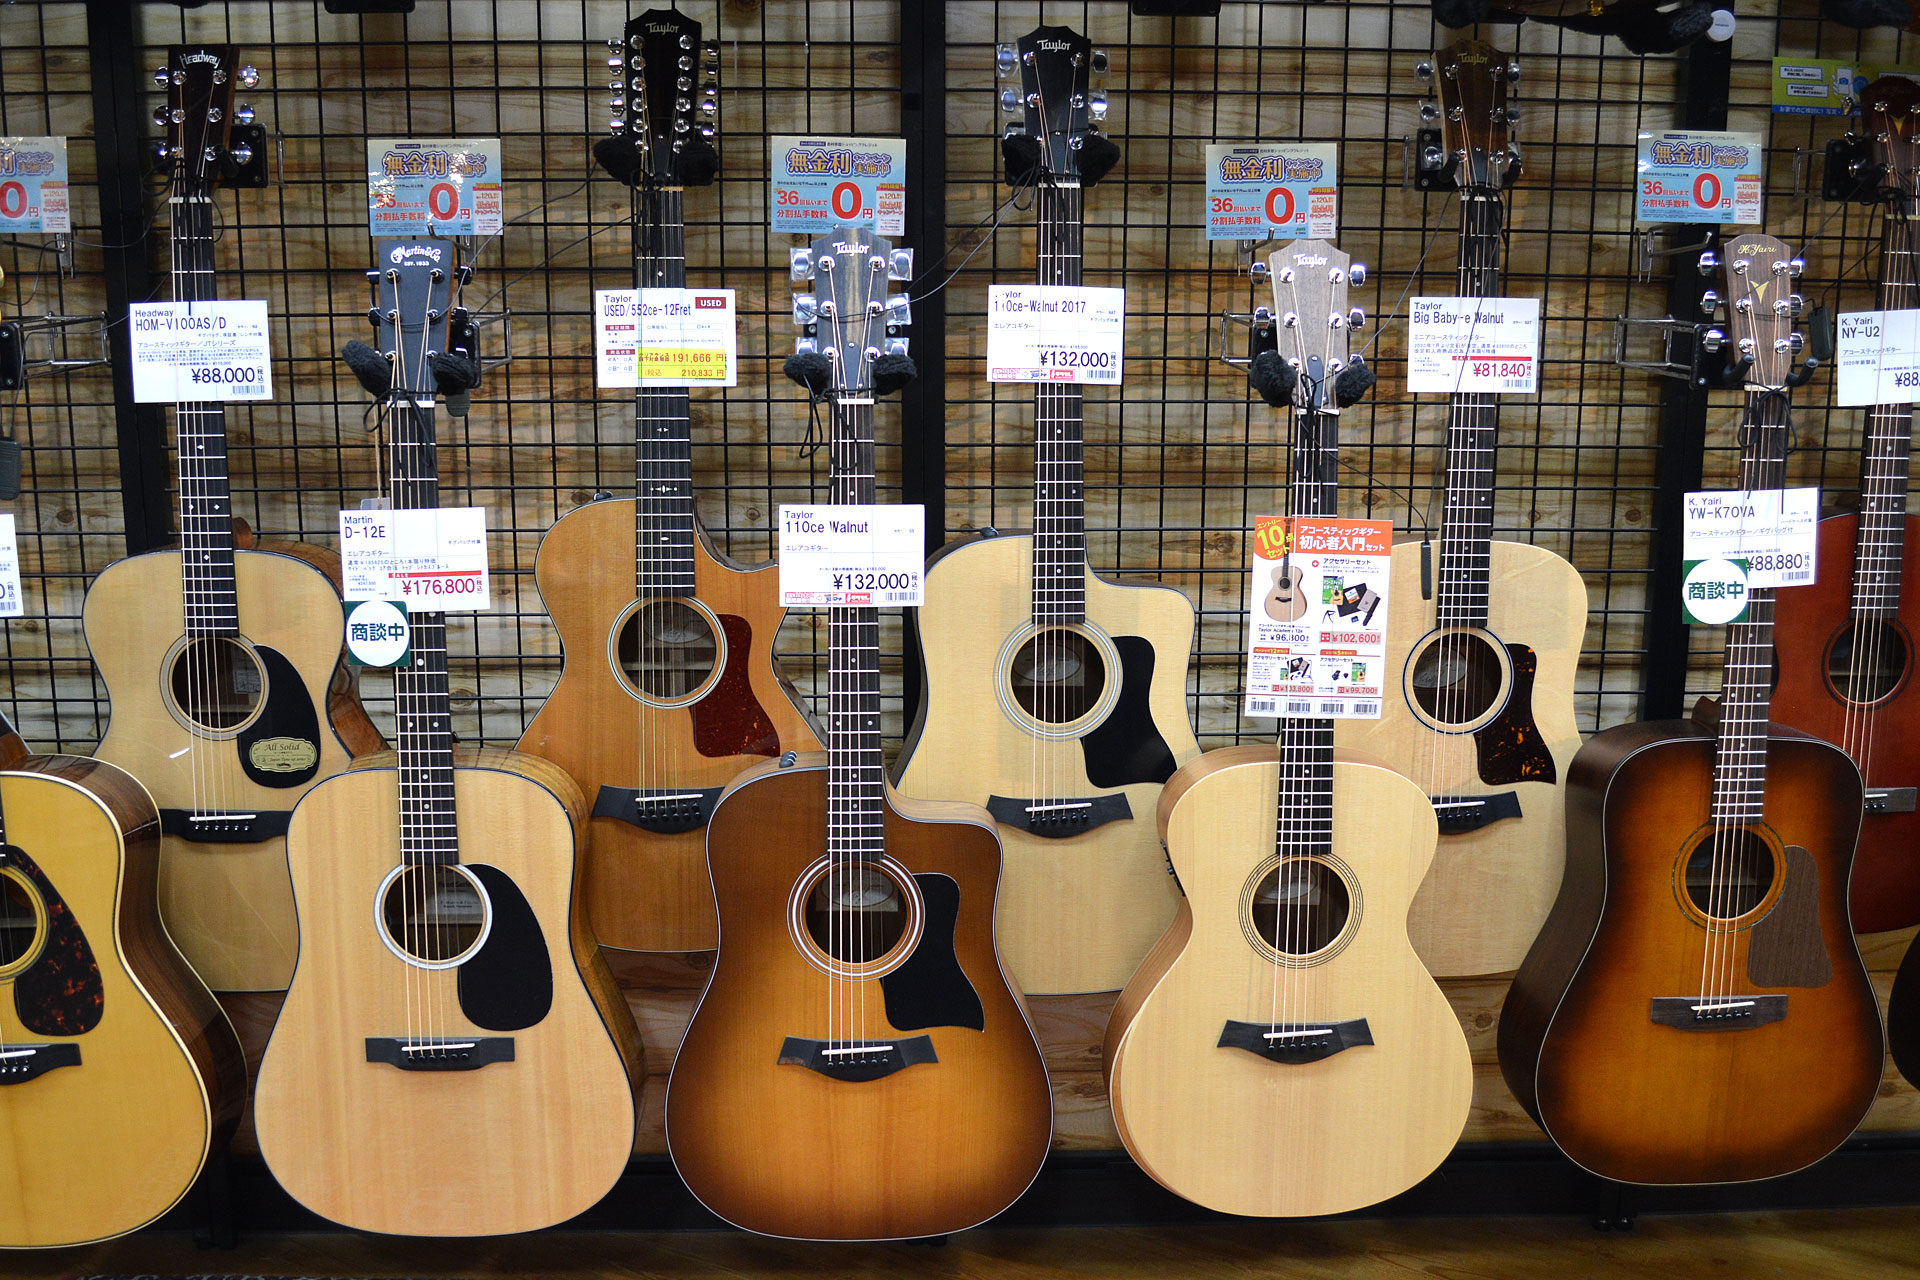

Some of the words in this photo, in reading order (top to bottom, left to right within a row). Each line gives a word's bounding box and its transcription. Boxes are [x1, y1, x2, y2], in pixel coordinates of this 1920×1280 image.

[645, 22, 680, 36] Taylor
[1037, 39, 1071, 53] Taylor
[179, 50, 221, 69] Headway
[1457, 52, 1489, 65] Taylor
[1653, 143, 1710, 165] 無金利
[385, 153, 446, 176] 無金利
[787, 151, 850, 174] 無金利
[853, 162, 890, 174] 実施中
[1222, 158, 1283, 180] 無金利
[1286, 168, 1321, 179] 実施中
[777, 209, 828, 219] 分割払手数料
[1211, 216, 1262, 225] 分割払手数料
[832, 241, 870, 257] Taylor
[1293, 253, 1328, 268] Taylor
[604, 295, 632, 303] Taylor
[995, 291, 1021, 299] ylor
[604, 304, 691, 317] USED/552ce-12Fret
[1062, 301, 1086, 313] 2017
[1414, 302, 1442, 310] Taylor
[135, 309, 174, 318] Headway
[1414, 312, 1429, 325] Big
[1475, 312, 1504, 324] Walnut
[135, 317, 227, 331] HOM-V100AS/D
[1854, 317, 1873, 325] Yairi
[1842, 326, 1880, 339] NY-U2
[1041, 351, 1109, 368] ¥132,000
[191, 367, 255, 384] ¥88,000
[1473, 363, 1526, 378] ¥81,840
[1701, 497, 1722, 505] Yairi
[784, 511, 813, 519] Taylor
[1689, 506, 1755, 519] YW-K70VA
[344, 516, 373, 524] Martin
[1257, 519, 1281, 528] エントリー
[345, 526, 386, 539] D-12E
[786, 521, 824, 533] 110ce
[830, 521, 868, 533] Walnut
[1300, 525, 1381, 535] アコースティックギター
[1299, 535, 1384, 551] 初心者入門セット
[1266, 545, 1290, 558] セット
[1323, 557, 1371, 565] アクセサリーセット
[1746, 554, 1803, 571] ¥88,880
[402, 578, 475, 595] ¥176,800
[833, 573, 909, 590] ¥132,000
[1688, 581, 1744, 600] 商談中
[351, 623, 404, 641] 商談中
